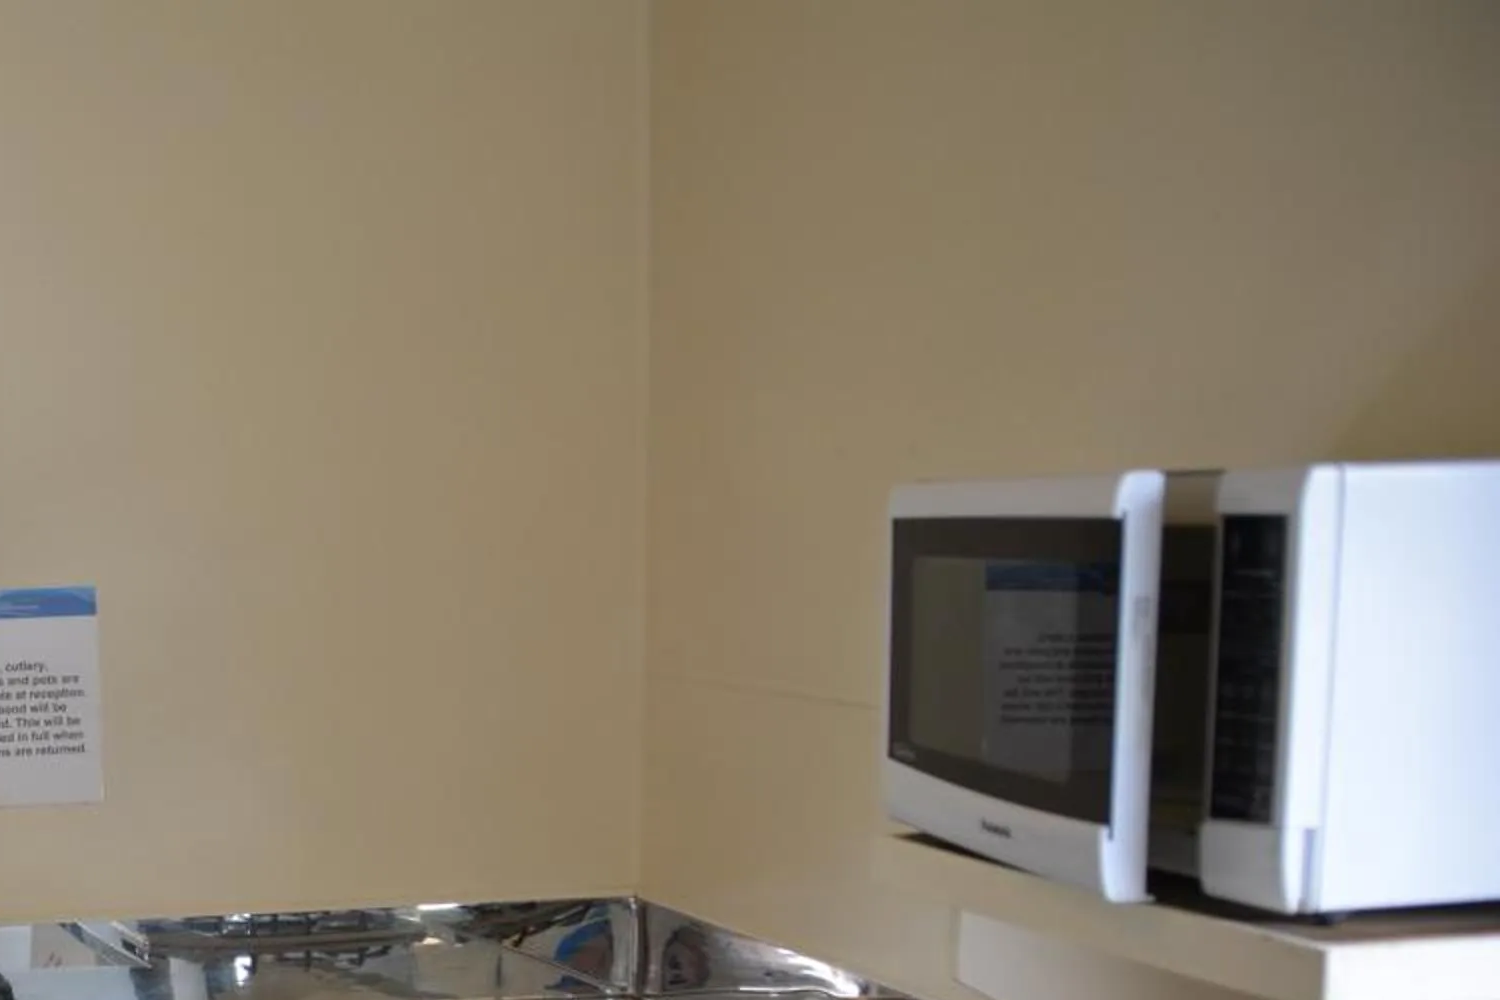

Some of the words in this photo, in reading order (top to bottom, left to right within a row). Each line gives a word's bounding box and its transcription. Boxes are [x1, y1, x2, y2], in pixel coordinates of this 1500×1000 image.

[7, 675, 29, 685] and
[32, 675, 57, 686] pots
[60, 674, 80, 684] are
[16, 690, 27, 700] at
[30, 703, 49, 713] will
[52, 702, 67, 713] be
[16, 717, 40, 728] This
[44, 716, 63, 727] will
[66, 716, 81, 726] be
[18, 732, 28, 742] in
[31, 731, 49, 742] full
[53, 730, 84, 740] when
[15, 748, 32, 757] are
